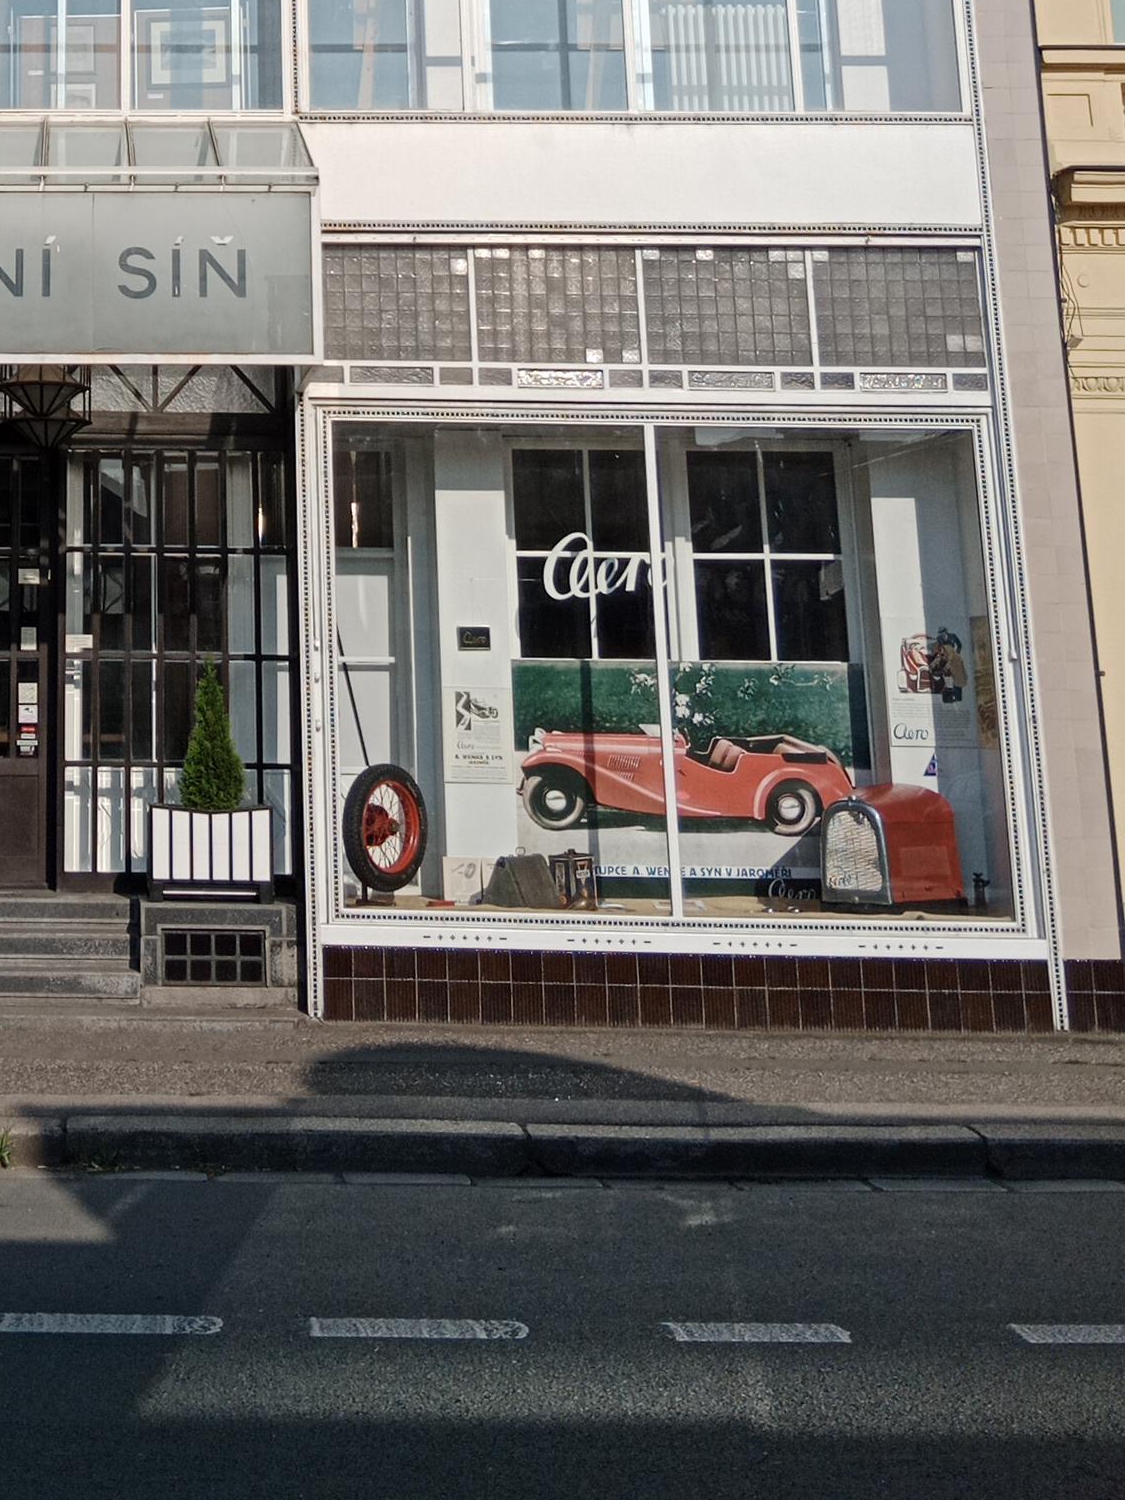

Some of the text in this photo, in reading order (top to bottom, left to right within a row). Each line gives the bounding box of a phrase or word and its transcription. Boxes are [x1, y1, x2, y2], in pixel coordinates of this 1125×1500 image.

[117, 235, 247, 299] SÍŇ
[893, 722, 929, 740] Aero
[646, 865, 686, 877] WENE
[699, 866, 722, 877] SYN
[725, 866, 733, 877] V
